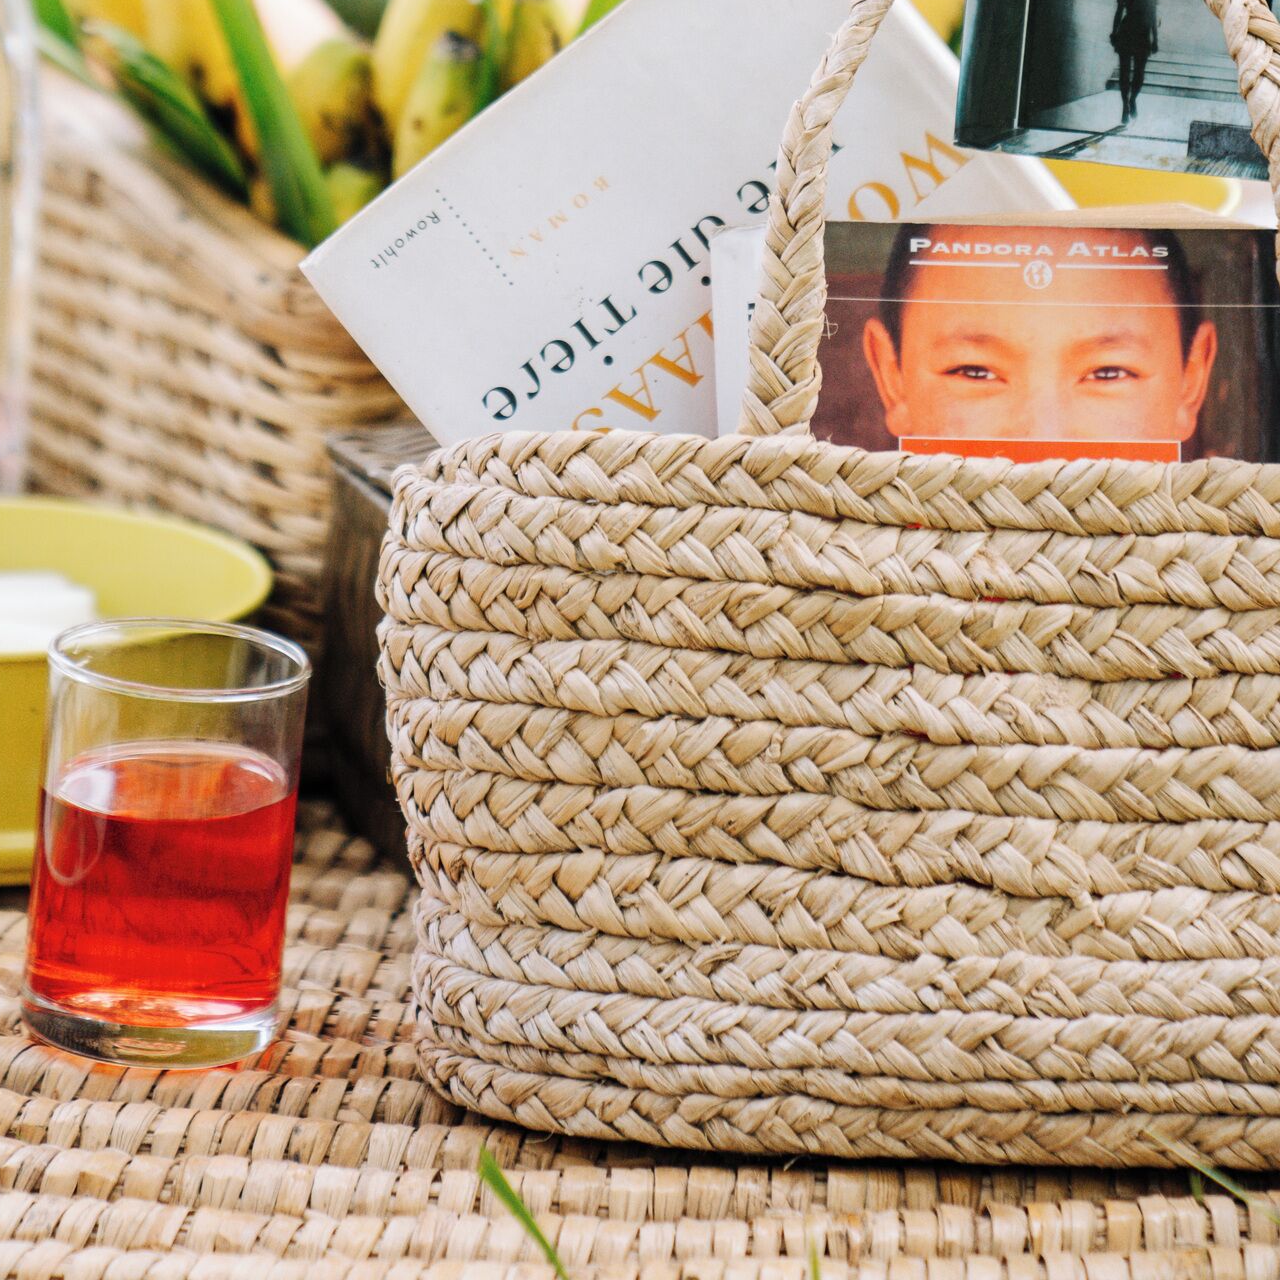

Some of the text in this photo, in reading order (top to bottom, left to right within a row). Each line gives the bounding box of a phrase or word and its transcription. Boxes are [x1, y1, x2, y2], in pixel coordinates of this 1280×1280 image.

[508, 175, 611, 261] ROMAN
[847, 130, 975, 221] WO
[369, 210, 441, 269] Rowohlt
[909, 237, 1169, 258] PANDORA ATLAS
[481, 294, 638, 421] Tiere
[572, 309, 715, 433] AAS
